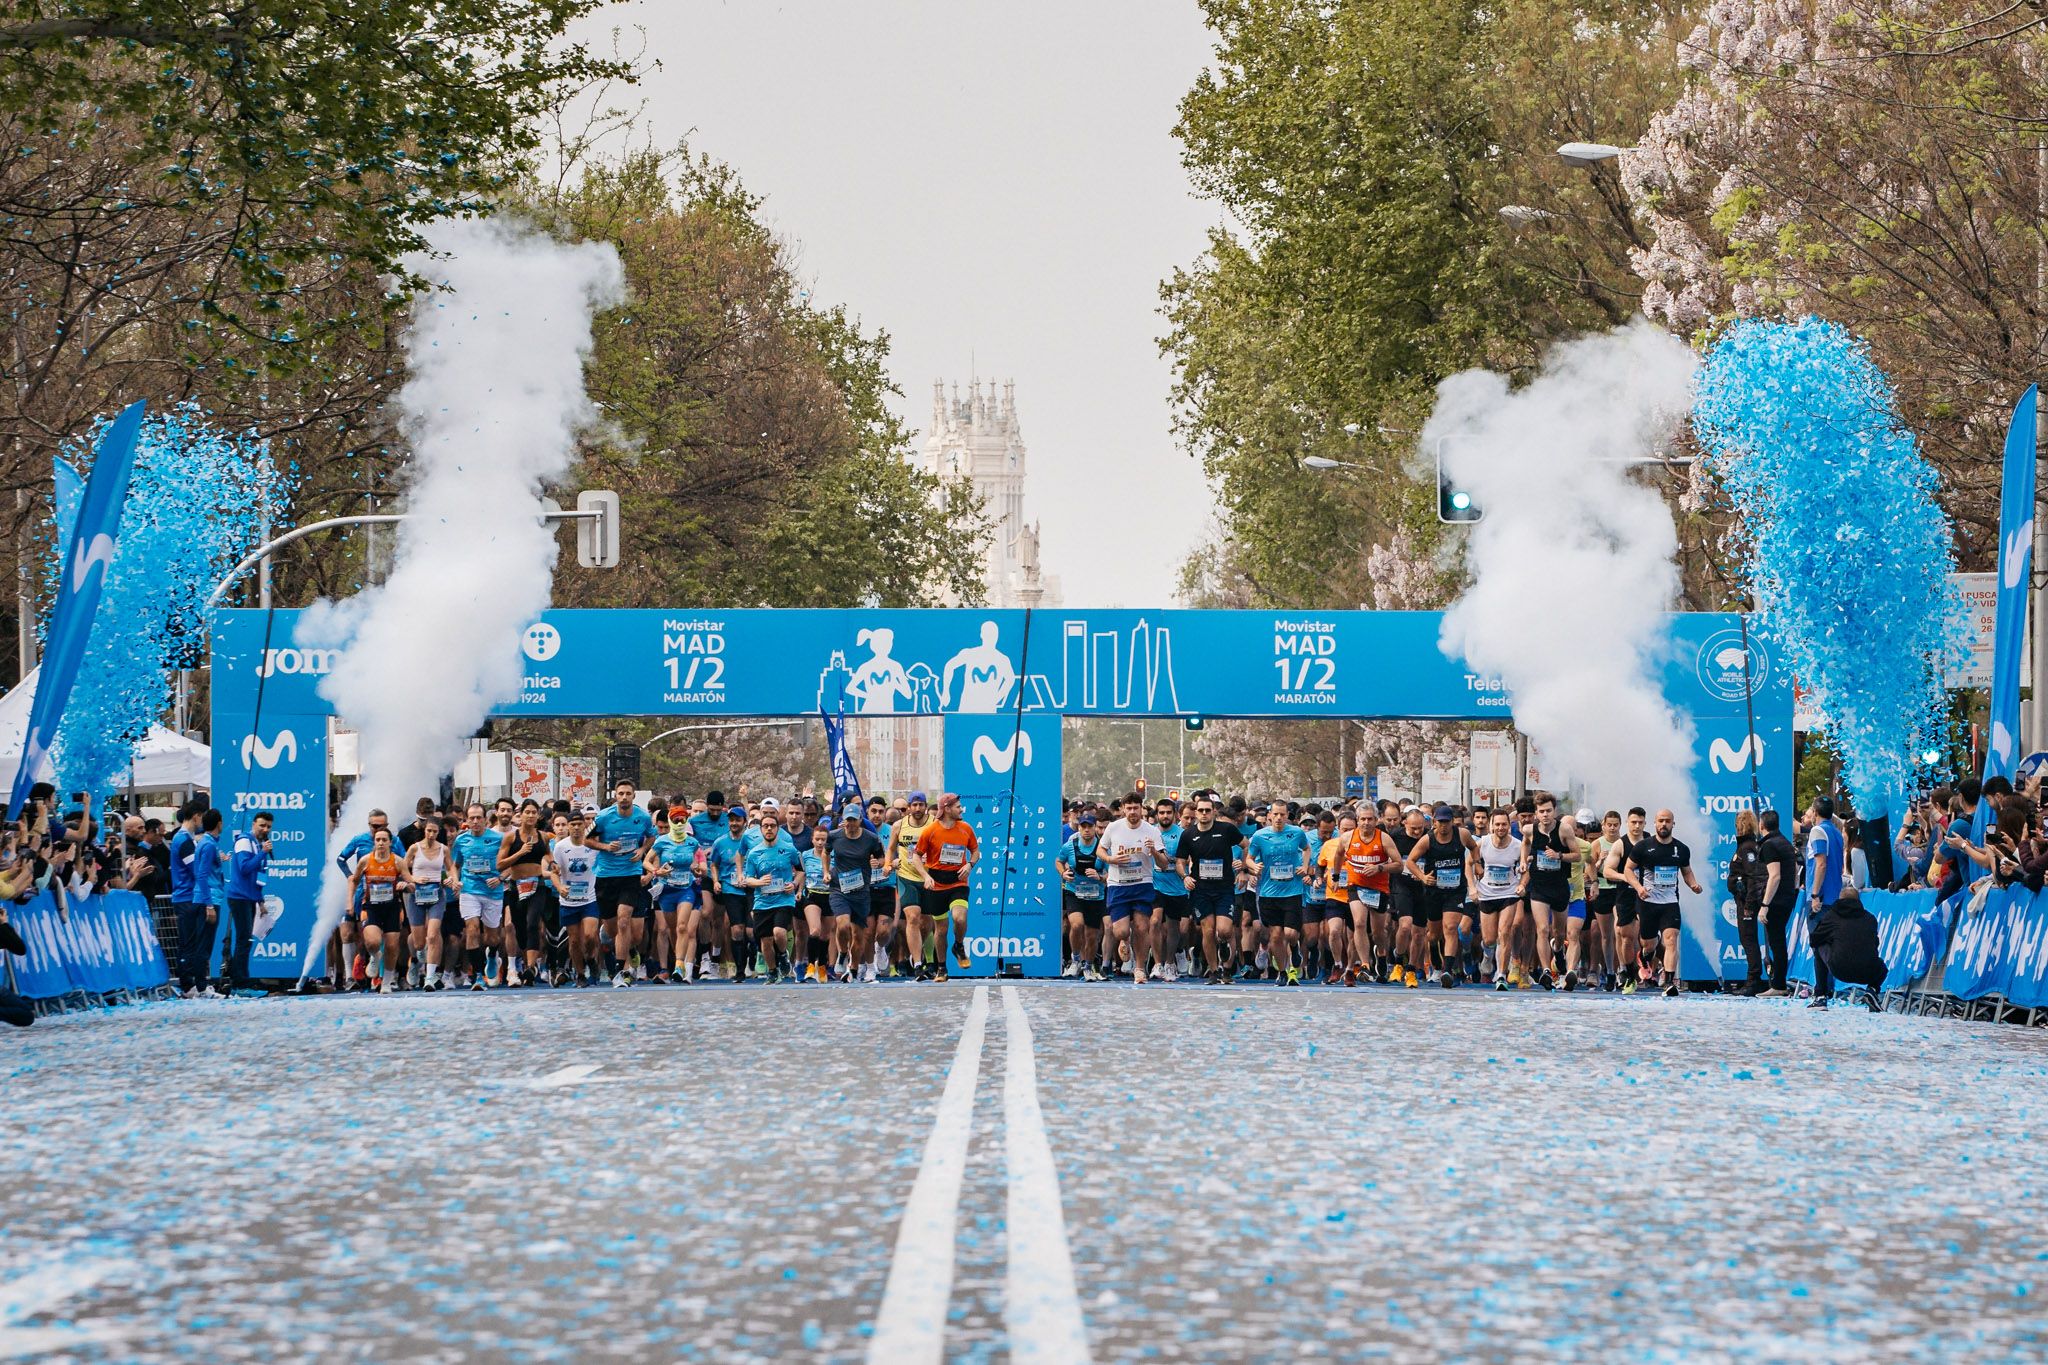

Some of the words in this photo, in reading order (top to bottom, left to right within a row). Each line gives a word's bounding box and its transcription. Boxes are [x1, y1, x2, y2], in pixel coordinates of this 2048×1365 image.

[663, 619, 725, 631] Movistar
[1275, 620, 1336, 632] Movistar
[663, 634, 725, 654] MAD
[1275, 635, 1336, 655] MAD
[255, 648, 343, 678] Jom
[663, 657, 725, 689] 1/2
[1275, 658, 1336, 690] 1/2
[521, 693, 546, 704] 1924
[663, 690, 725, 703] MARATÓN
[1275, 692, 1336, 704] MARATÓN
[1351, 854, 1381, 863] MADRID
[268, 868, 308, 877] Madrid
[253, 942, 297, 957] ADM
